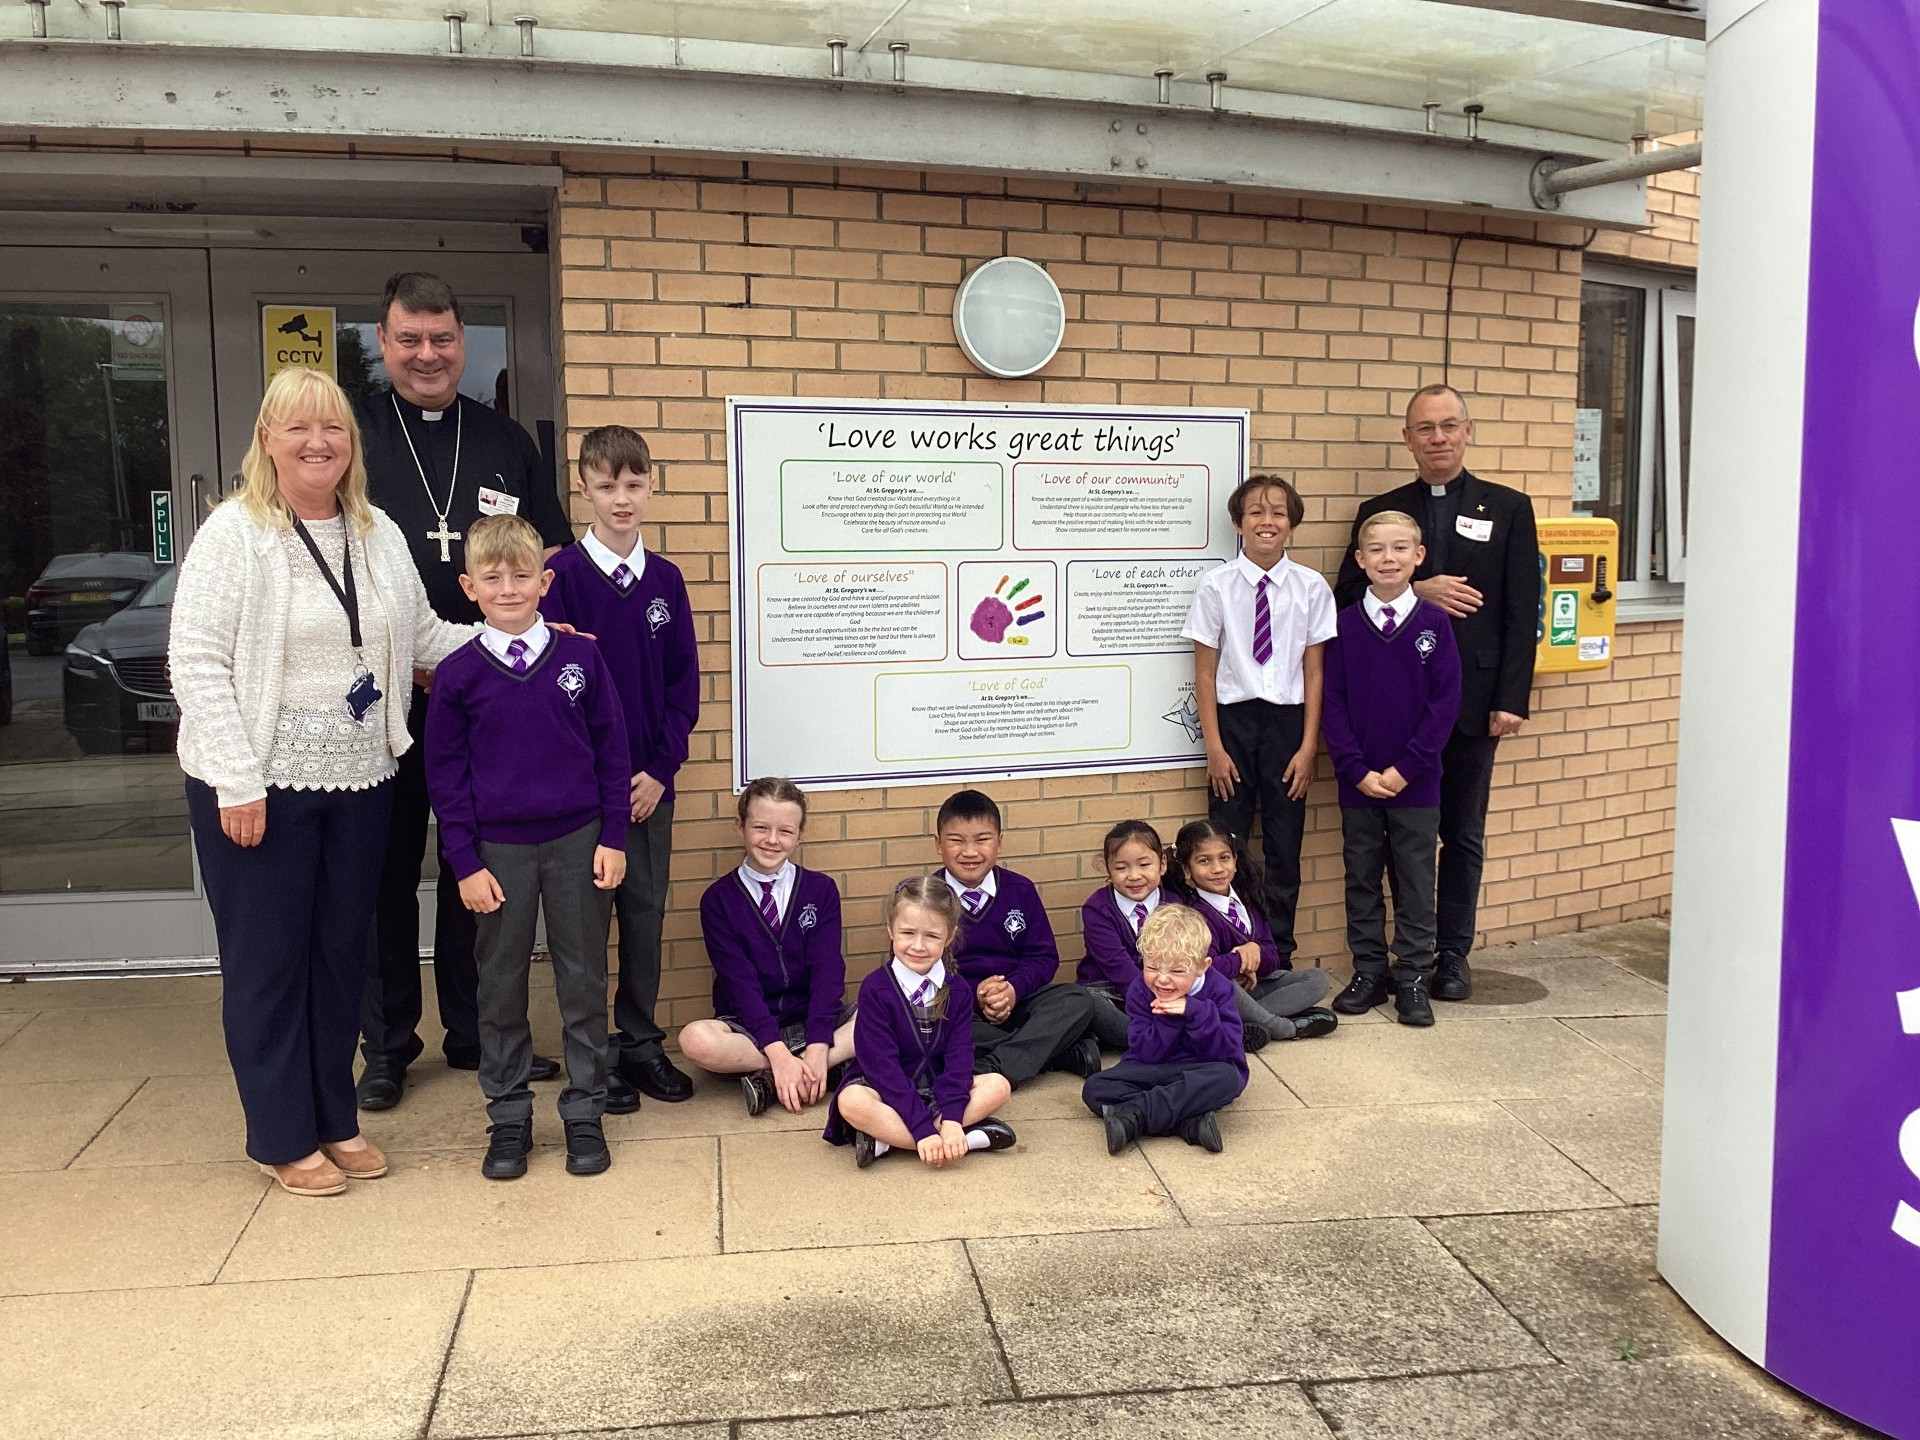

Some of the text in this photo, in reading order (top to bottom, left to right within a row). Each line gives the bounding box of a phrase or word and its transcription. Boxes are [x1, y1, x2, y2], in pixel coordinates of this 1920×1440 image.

[277, 350, 322, 364] CCTV
[819, 423, 1180, 461] 'Love works great things'
[833, 472, 866, 482] 'Love
[872, 470, 885, 483] of
[917, 471, 955, 483] world'
[1041, 474, 1071, 484] 'Love
[1076, 472, 1088, 484] of
[1115, 474, 1184, 488] community"
[158, 510, 167, 557] PULL
[794, 570, 914, 583] 'Love of ourselves"
[1092, 566, 1203, 578] 'Love of each other"
[969, 677, 1046, 691] 'Love of God'
